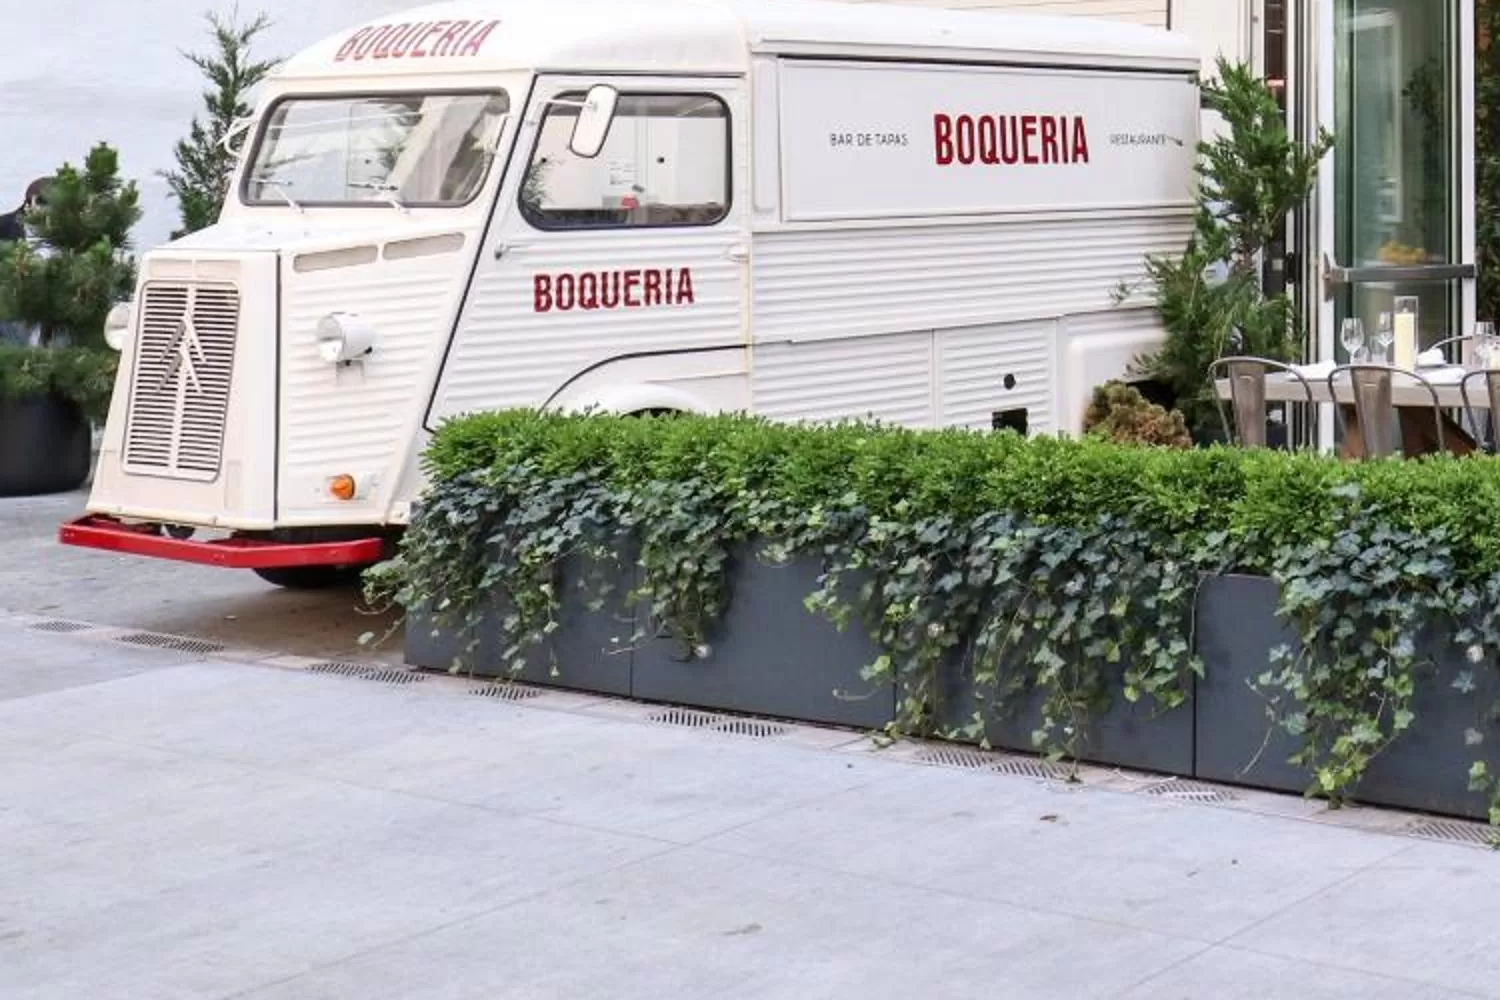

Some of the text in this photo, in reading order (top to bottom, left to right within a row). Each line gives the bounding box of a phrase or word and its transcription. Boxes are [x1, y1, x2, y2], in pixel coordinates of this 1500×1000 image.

[334, 19, 502, 62] BOQUERIA
[830, 132, 910, 147] BAR DE TAPAS
[933, 113, 1089, 165] BOQUERIA
[533, 267, 695, 313] BOQUERIA
